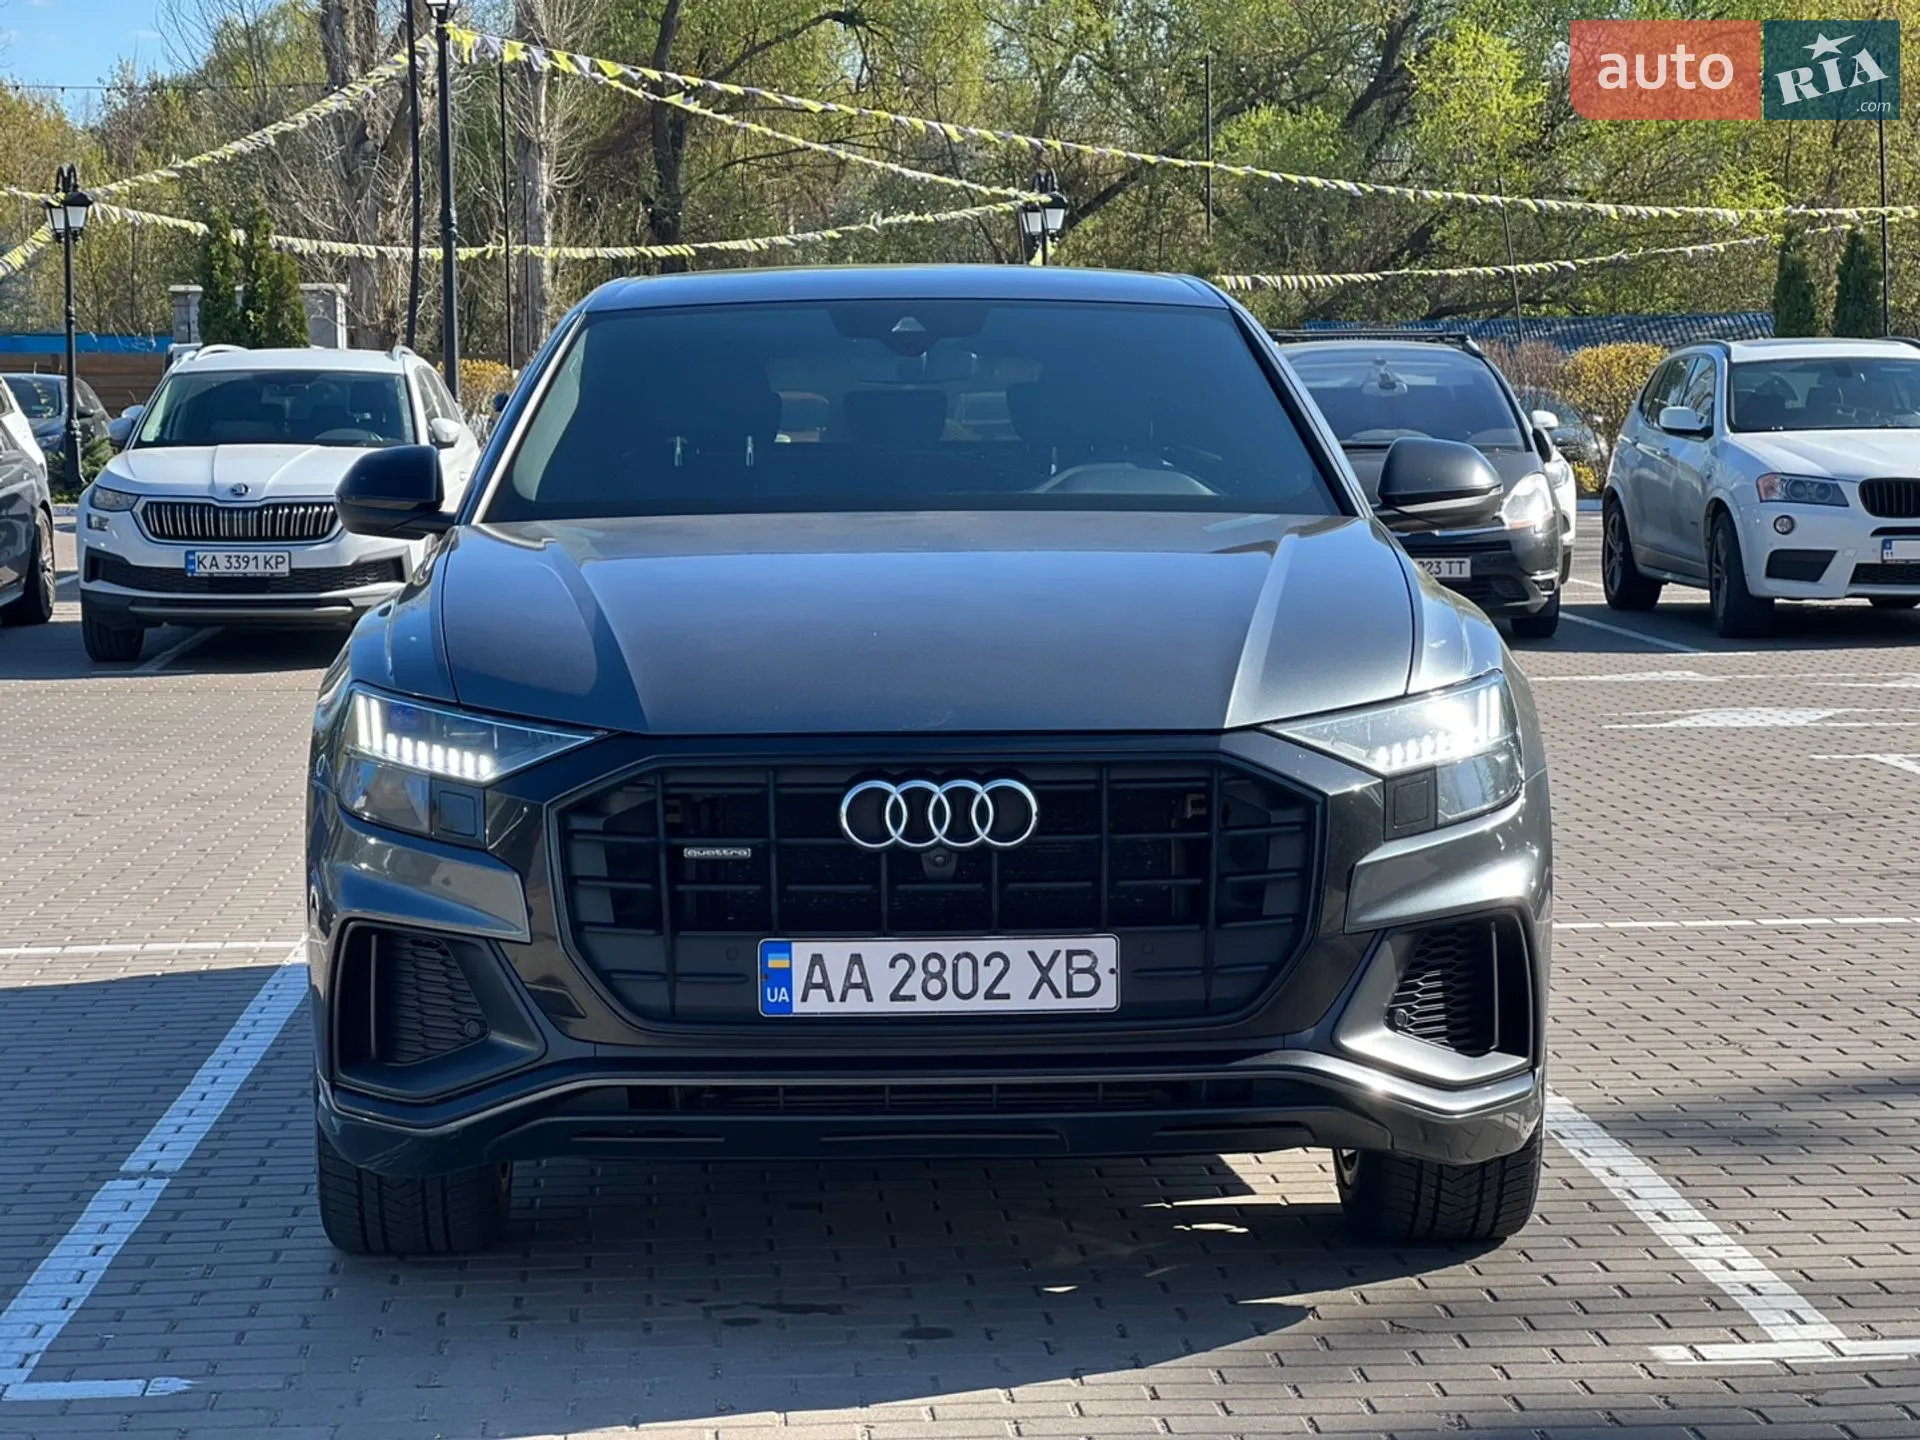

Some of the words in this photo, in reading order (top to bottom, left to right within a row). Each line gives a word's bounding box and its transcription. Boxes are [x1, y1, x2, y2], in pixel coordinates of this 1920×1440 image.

[197, 554, 220, 570] KA
[223, 554, 259, 570] 3391
[263, 554, 286, 570] KP
[1445, 560, 1467, 575] TT
[685, 848, 751, 858] quattro
[799, 953, 874, 1003] AA
[888, 951, 1012, 1003] 2802
[1027, 949, 1102, 1000] XB
[766, 987, 790, 1004] UA
